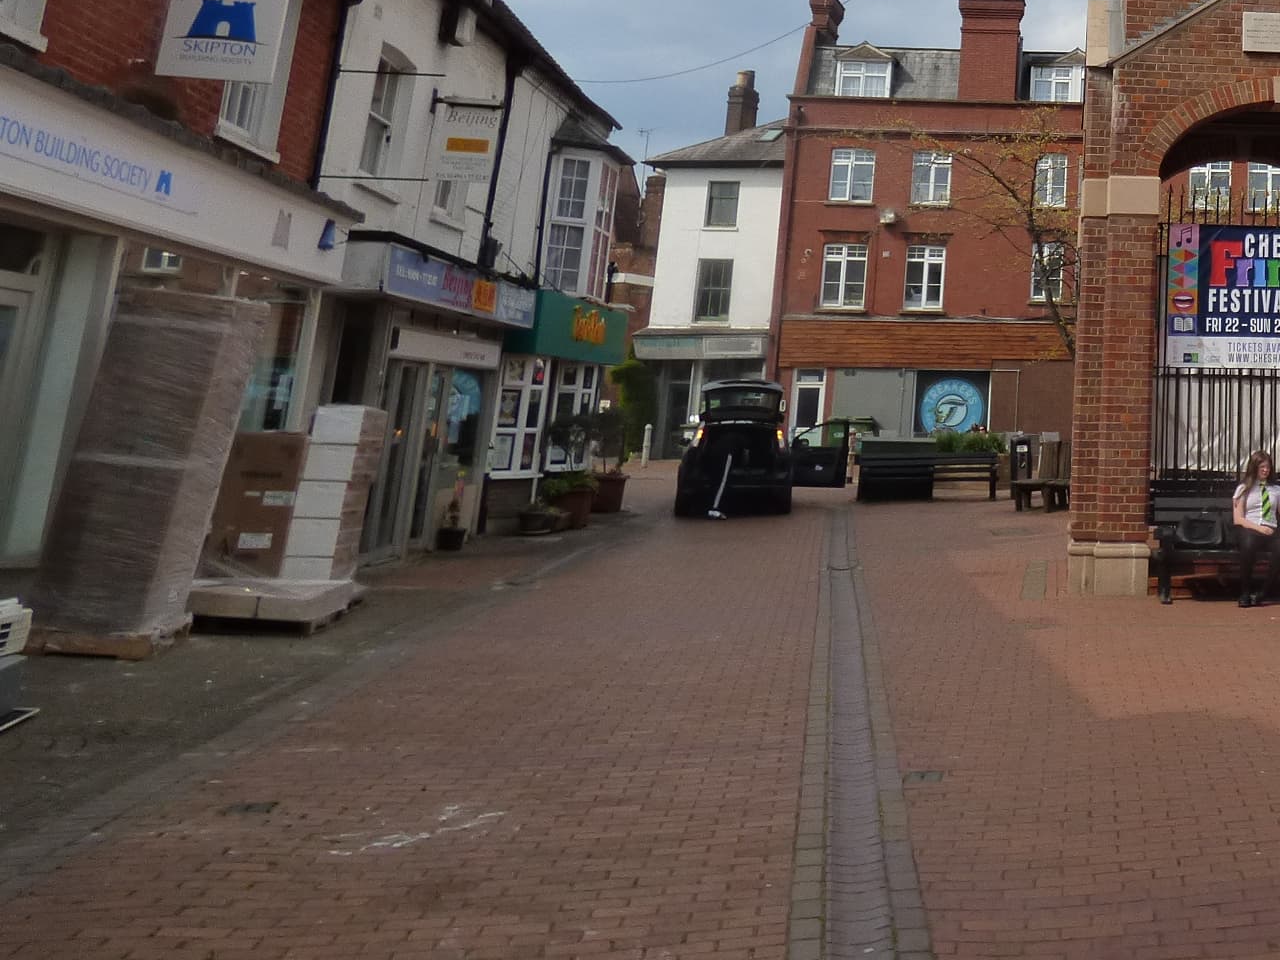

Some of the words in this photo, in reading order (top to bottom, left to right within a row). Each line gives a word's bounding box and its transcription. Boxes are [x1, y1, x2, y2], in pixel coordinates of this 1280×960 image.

[183, 40, 256, 56] SKIPTON
[447, 111, 498, 128] Beijing
[34, 129, 101, 173] BUILDING
[102, 155, 151, 192] SOCIETY
[1205, 318, 1222, 333] FRI
[1225, 317, 1239, 333] 22
[1250, 319, 1271, 333] SUN
[1228, 342, 1263, 353] TICKETS
